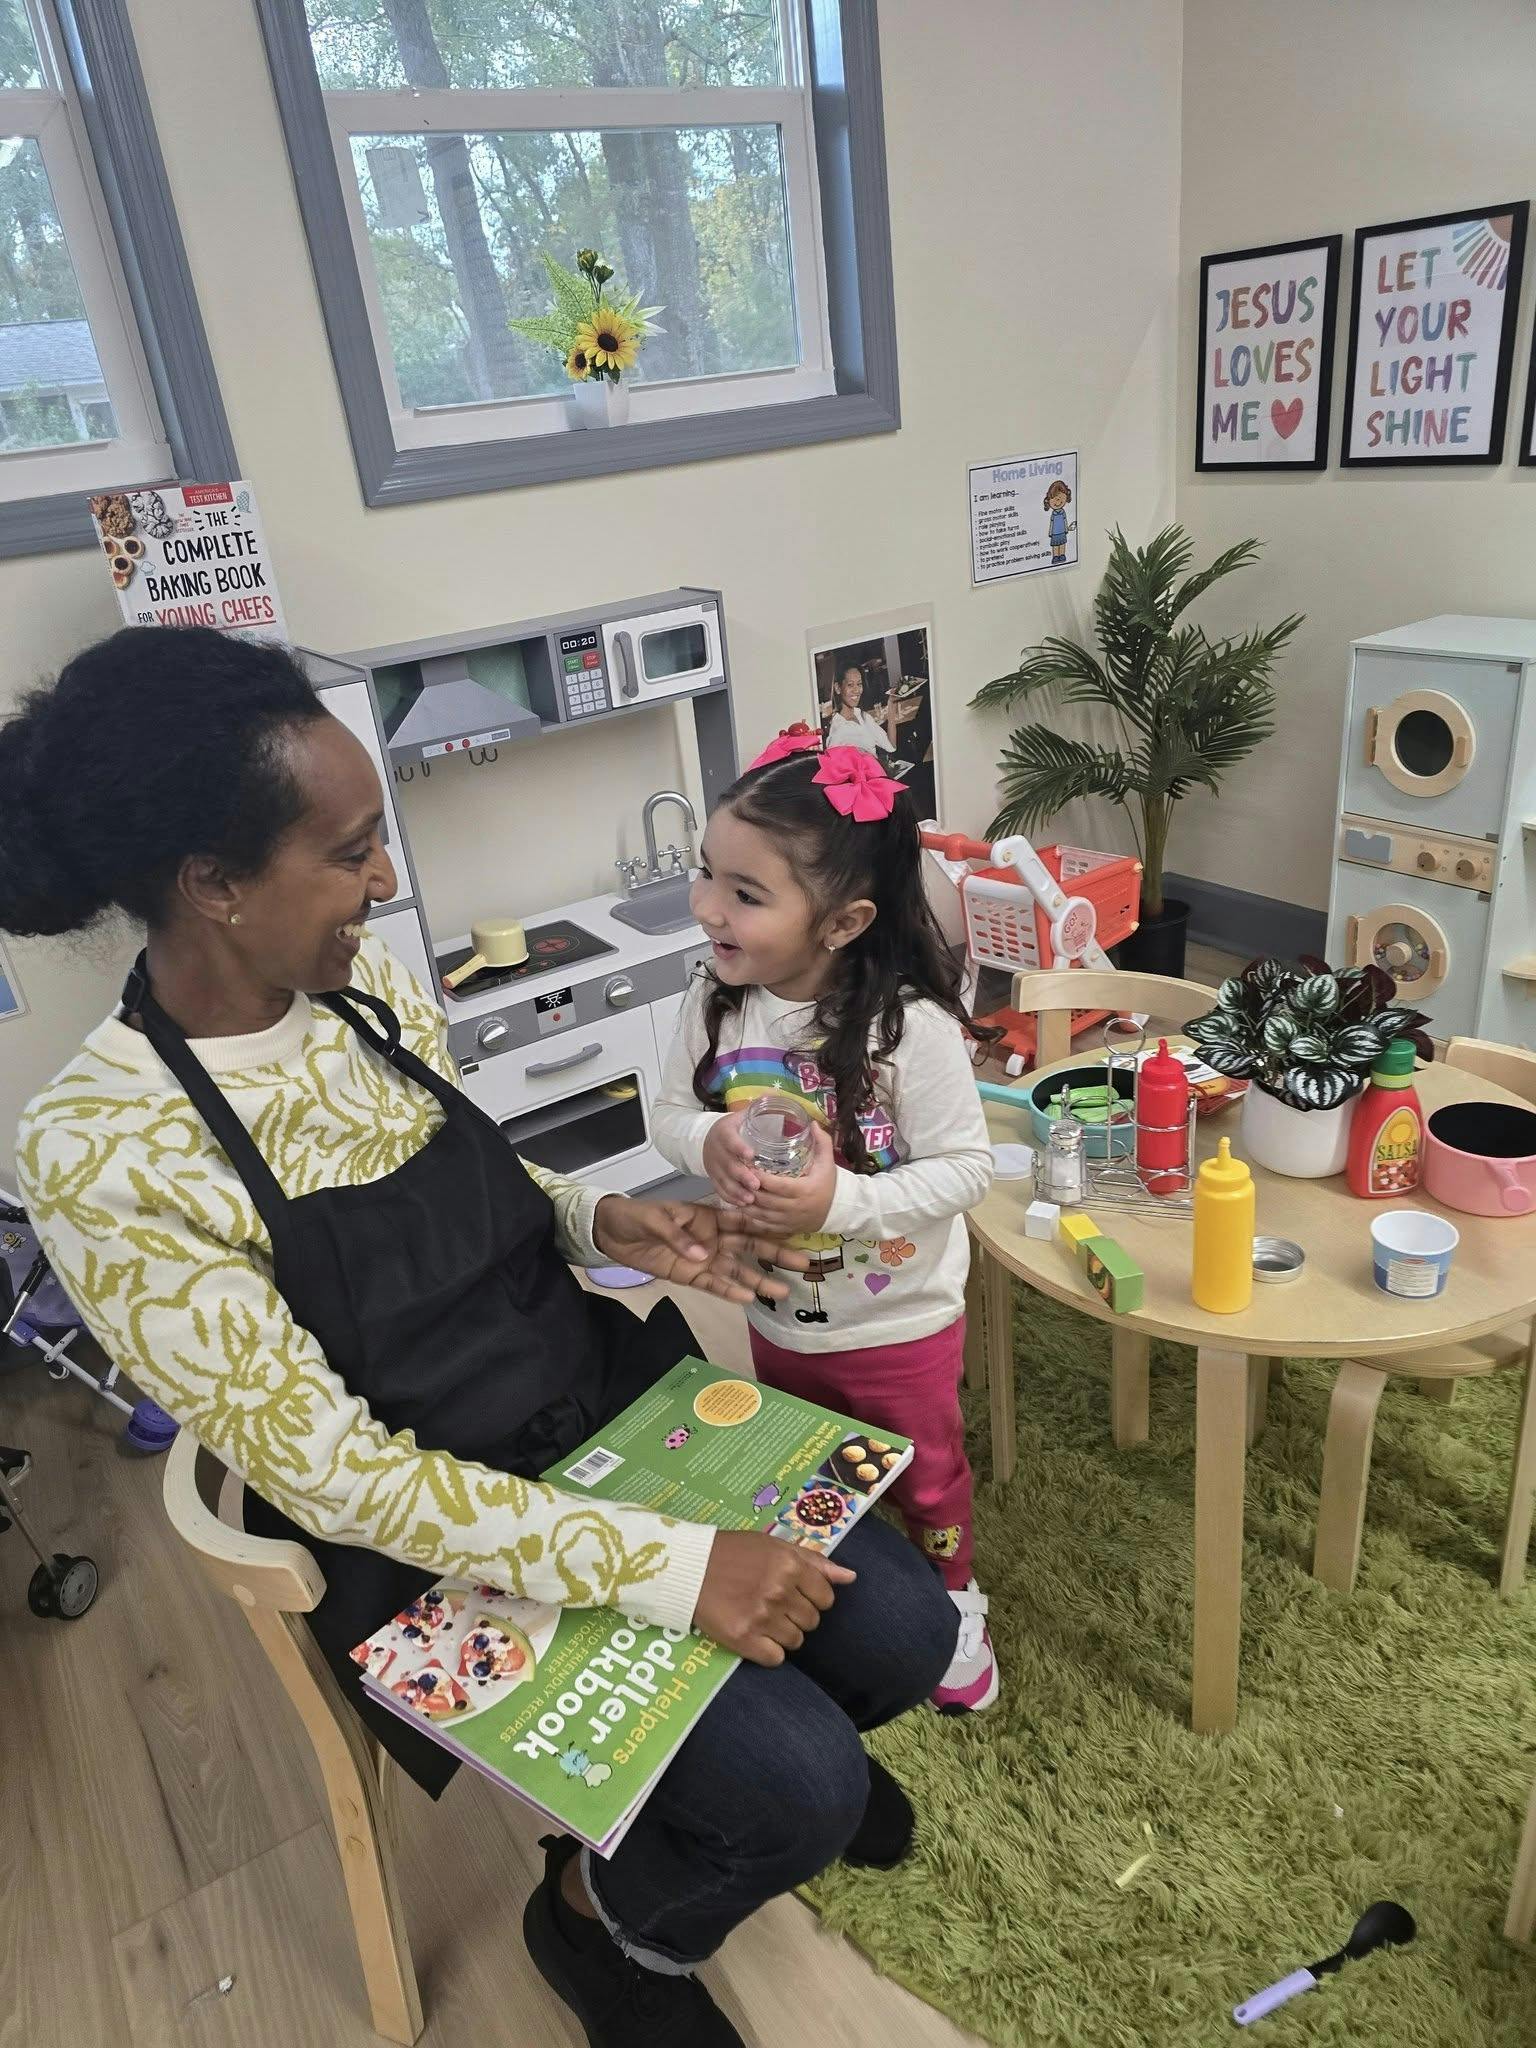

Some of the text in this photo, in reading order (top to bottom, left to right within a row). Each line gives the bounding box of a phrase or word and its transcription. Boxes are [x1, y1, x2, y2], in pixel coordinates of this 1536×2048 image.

[1376, 246, 1442, 295] LET
[1215, 275, 1318, 333] JESUS
[1374, 298, 1472, 348] YOUR
[1213, 337, 1316, 388] LOVES
[1369, 352, 1478, 398] LIGHT
[1211, 400, 1262, 444] ME
[1366, 405, 1472, 448] SHINE
[992, 461, 1063, 483] Home Living
[189, 492, 228, 504] TEST KITCHEN
[205, 511, 229, 527] THE
[162, 530, 258, 565] COMPLETE
[986, 561, 1005, 569] practice
[1006, 557, 1024, 565] problem
[146, 562, 267, 602] BAKING BOOK
[137, 595, 275, 627] FOR YOUNG CHEFS
[562, 636, 595, 649] 00:20
[863, 1125, 895, 1152] ER
[1376, 1139, 1417, 1160] SALSA
[776, 1421, 830, 1481] with Your Little Chef
[796, 1459, 810, 1471] Fun
[815, 1439, 829, 1449] Up
[544, 1620, 597, 1674] TOGETHER
[513, 1615, 649, 1759] okbook
[588, 1626, 699, 1744] oddler
[613, 1637, 718, 1764] ttle Helpers
[500, 1697, 544, 1743] RECIPES
